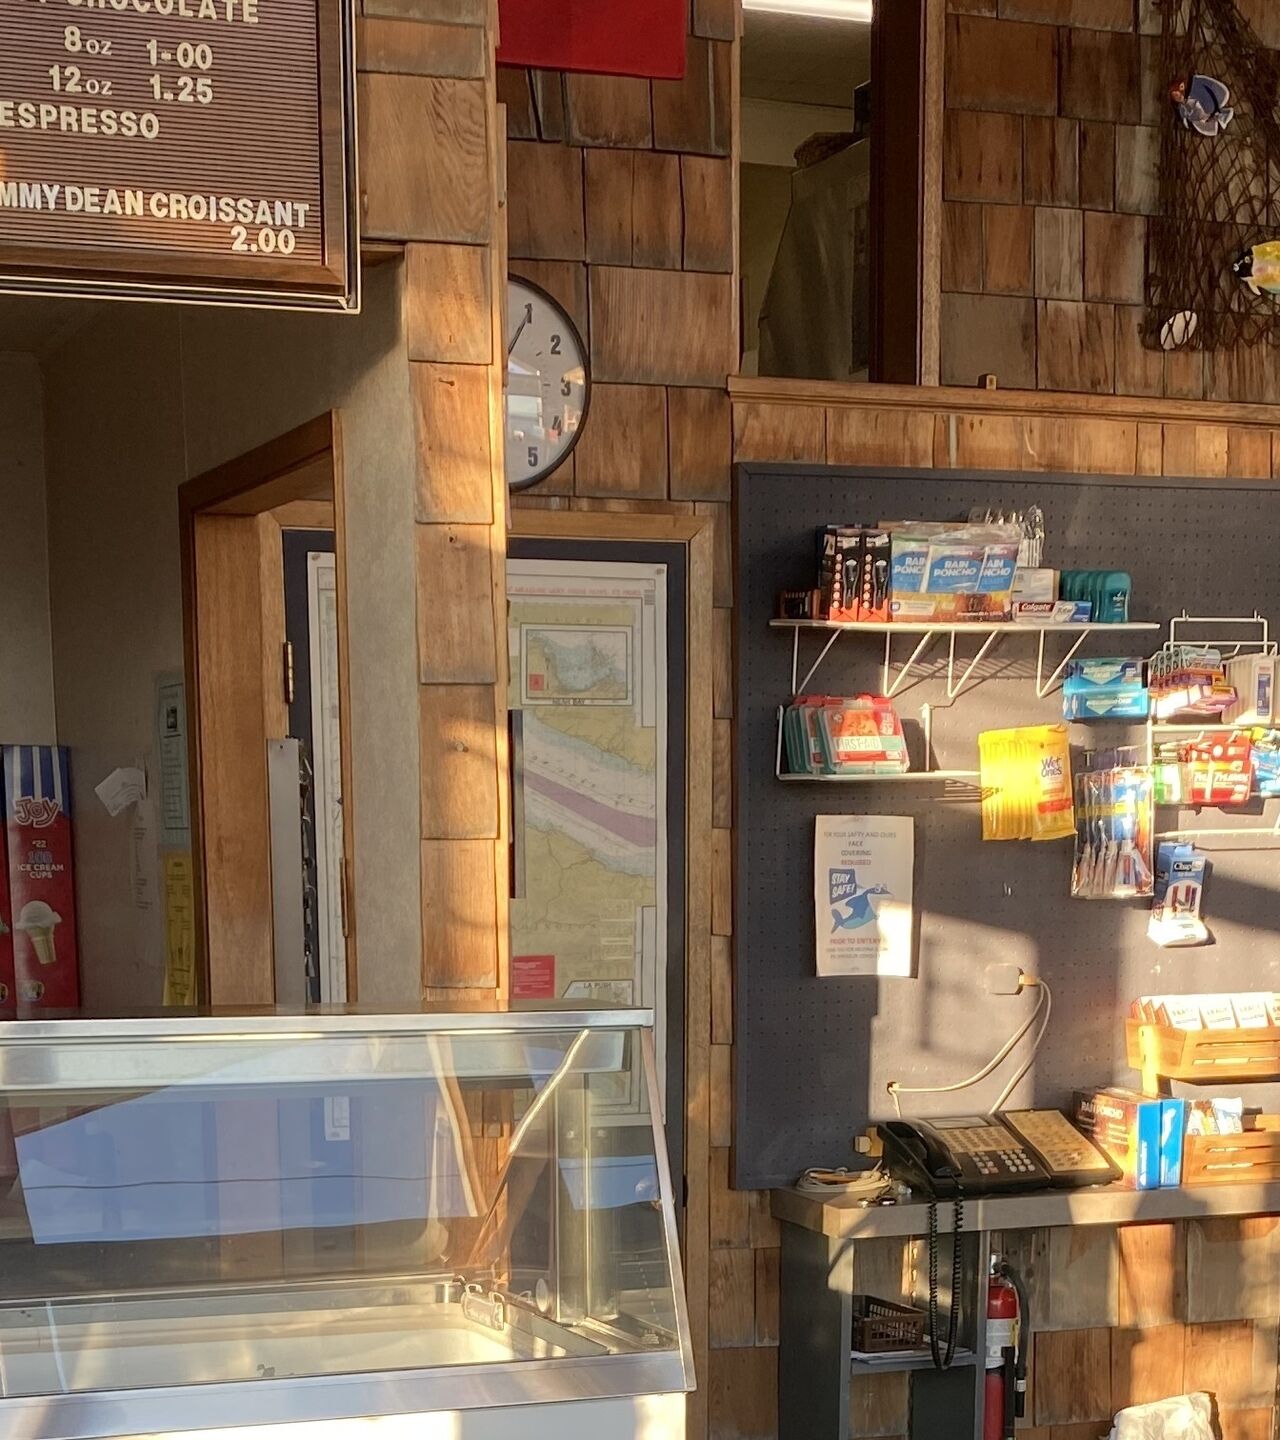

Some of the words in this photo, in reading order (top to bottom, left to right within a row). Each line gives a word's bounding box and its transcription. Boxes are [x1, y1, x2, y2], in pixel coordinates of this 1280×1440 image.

[67, 0, 258, 23] COLATE
[65, 186, 143, 217] DEAN
[148, 191, 310, 228] CROISSANT
[230, 225, 297, 255] 2.00
[550, 335, 561, 355] 2
[527, 446, 539, 467] 5
[987, 559, 1004, 568] AIN
[29, 872, 53, 880] CUPS
[34, 863, 64, 873] CREAM
